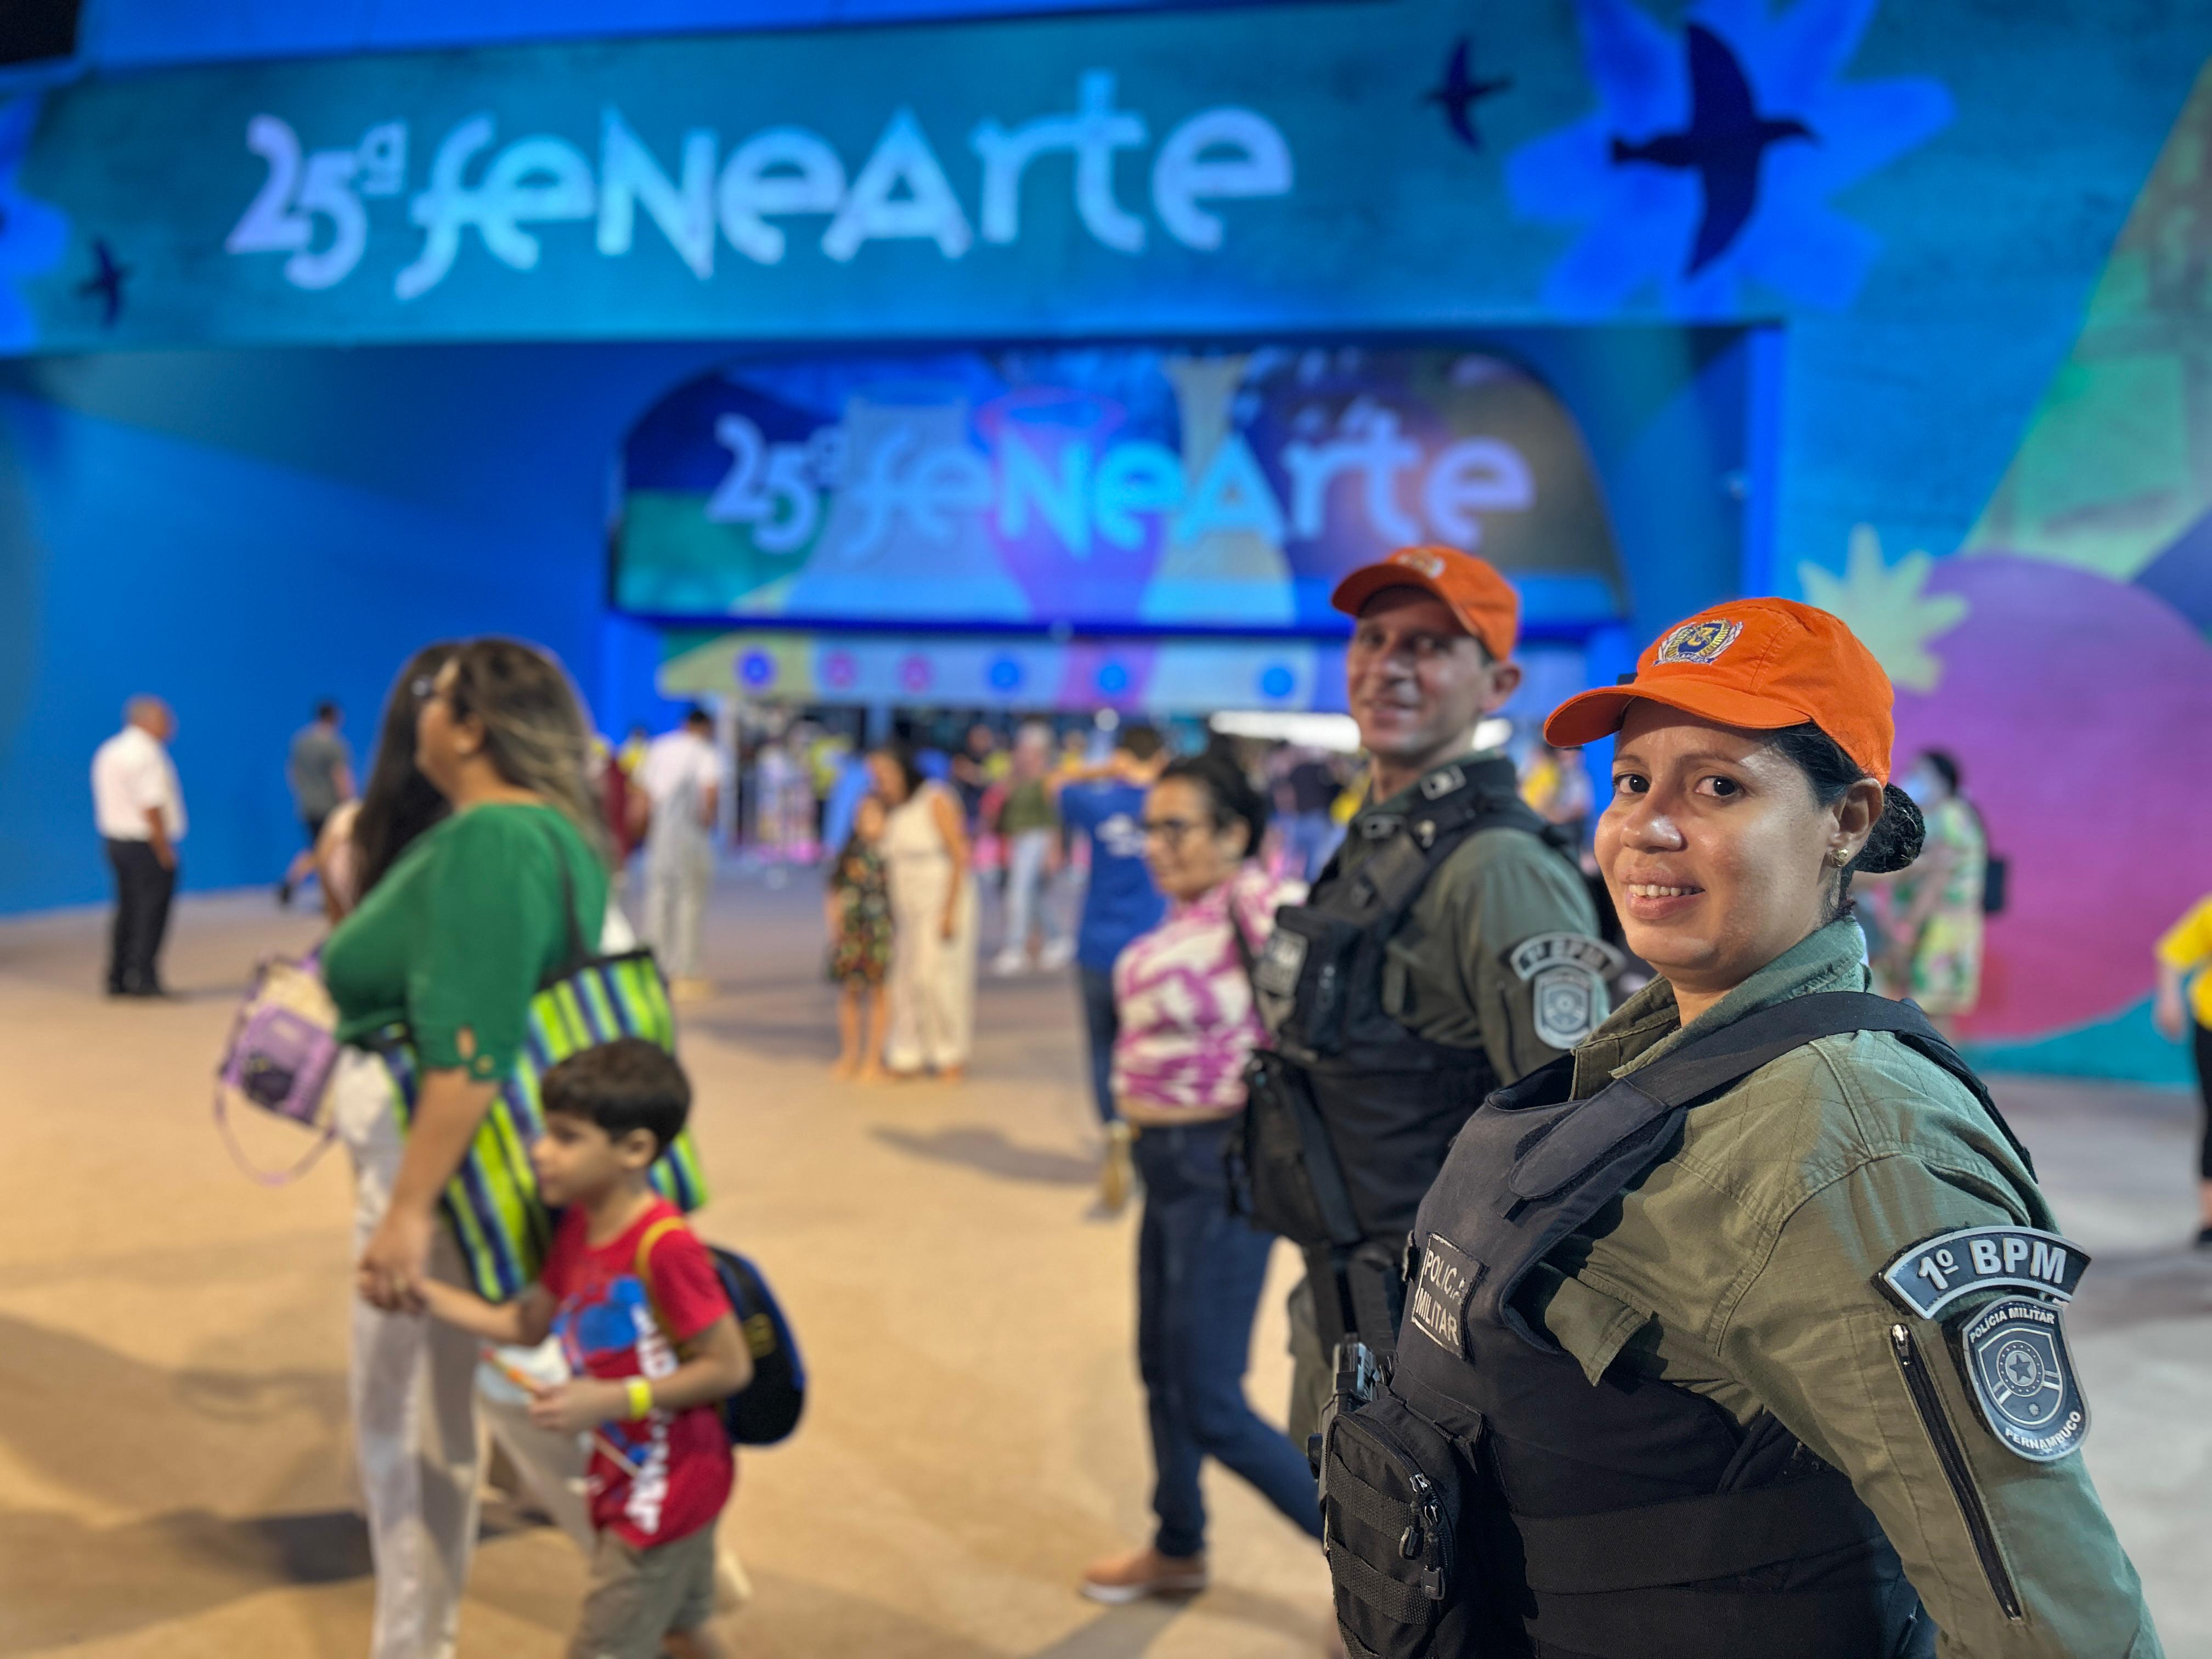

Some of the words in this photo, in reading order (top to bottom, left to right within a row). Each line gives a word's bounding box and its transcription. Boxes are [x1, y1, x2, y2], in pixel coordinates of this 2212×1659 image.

[1970, 1238, 2067, 1284] BPM
[1416, 1288, 1459, 1346] MILITAR
[2008, 1308, 2055, 1324] MILITAR
[2005, 1411, 2081, 1449] PERNAMBUCO
